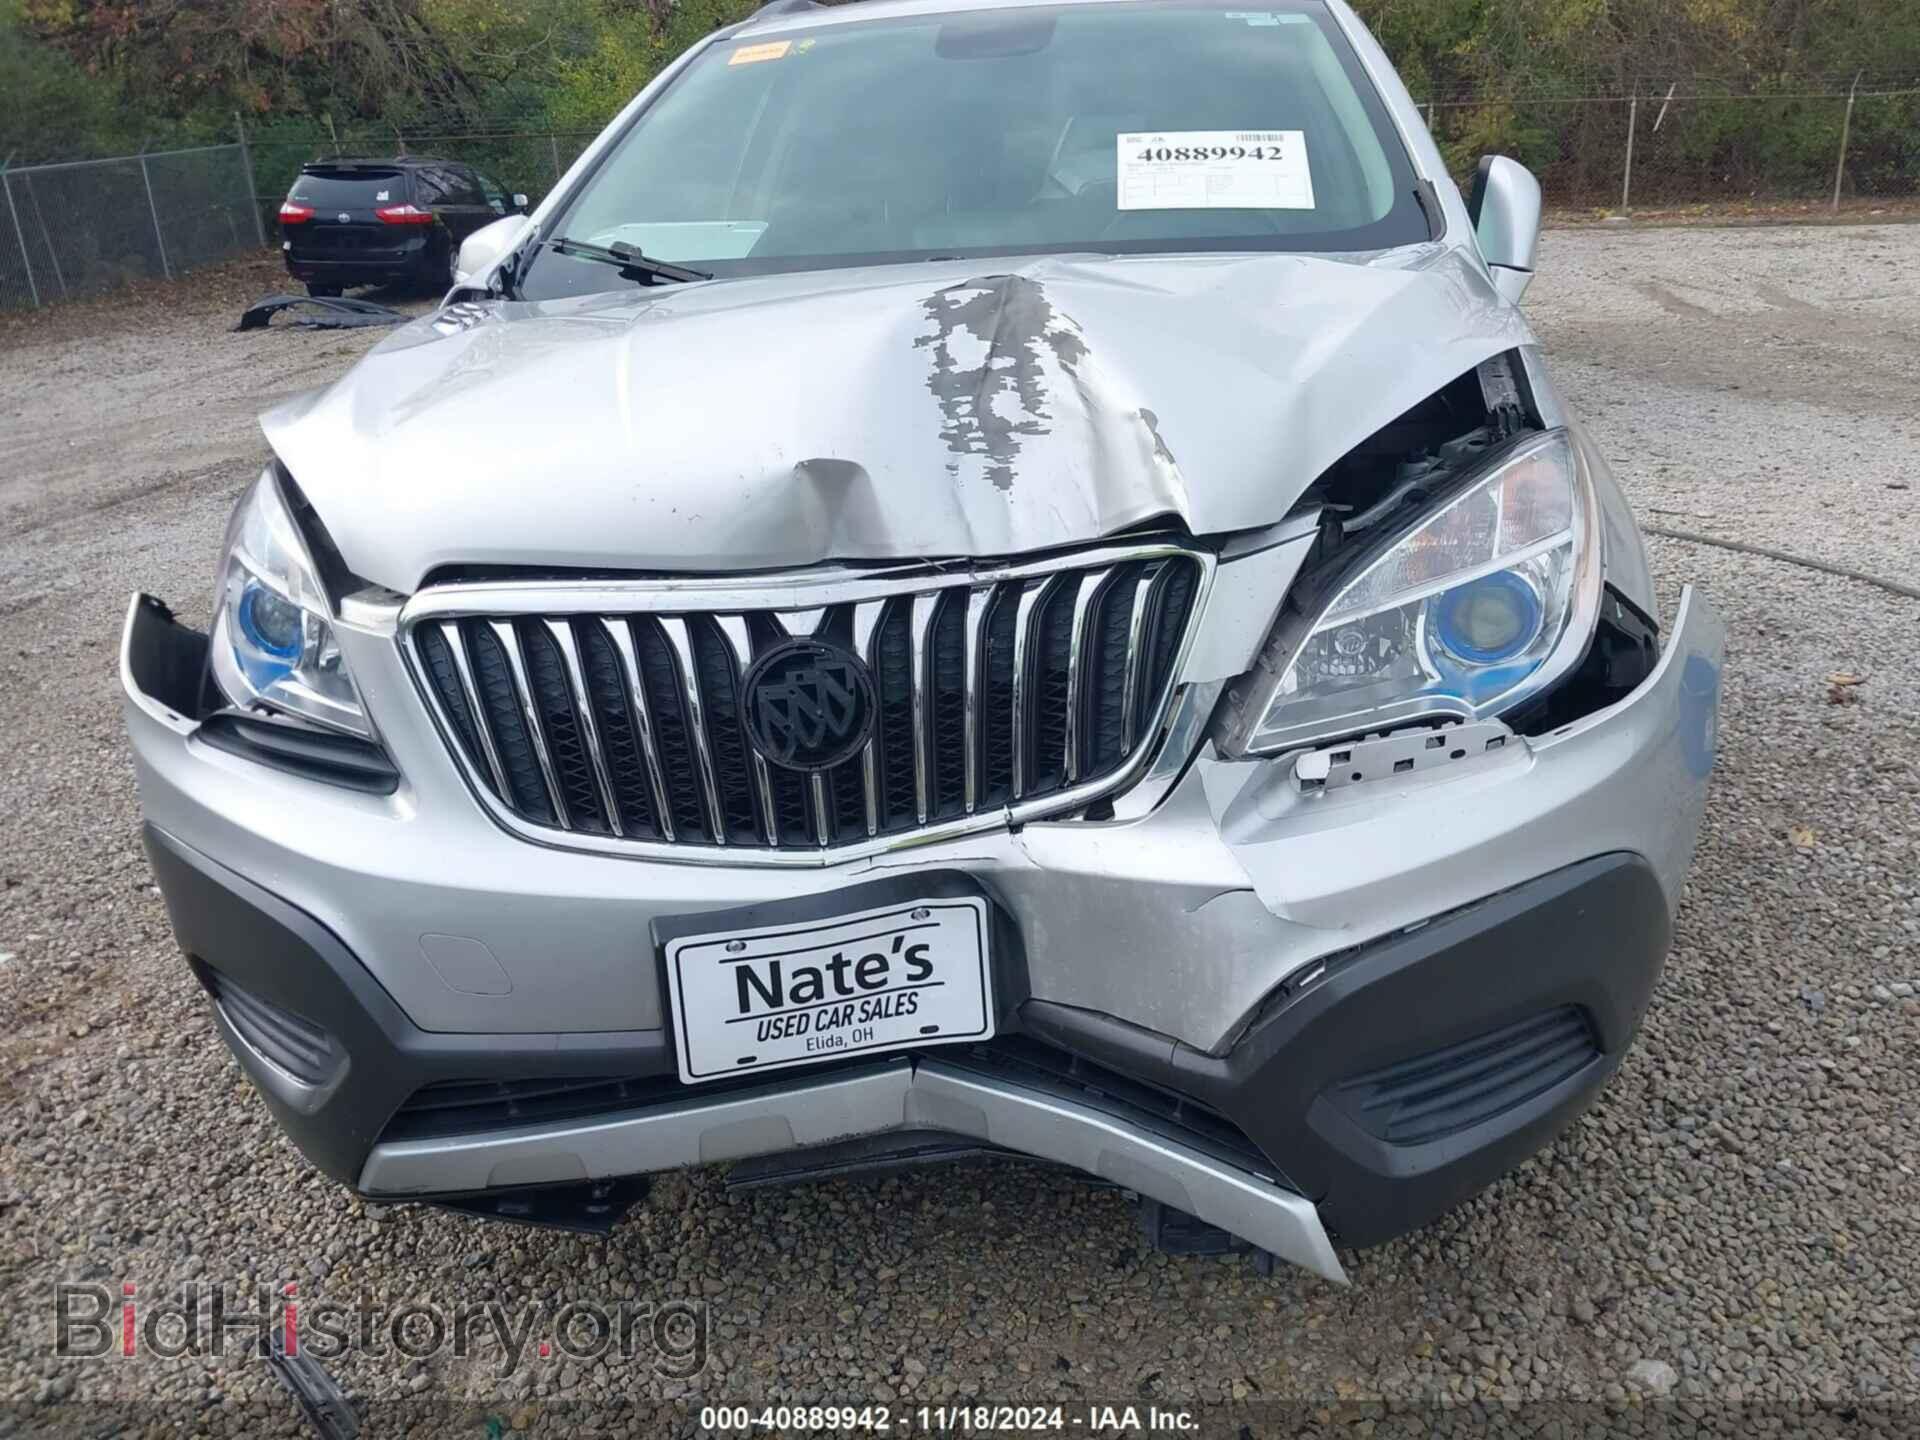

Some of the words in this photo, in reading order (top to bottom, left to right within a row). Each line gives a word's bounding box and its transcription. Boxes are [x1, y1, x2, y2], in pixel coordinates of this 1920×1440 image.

[1137, 146, 1283, 162] 40889942
[735, 935, 934, 1014] Nate's
[756, 1012, 811, 1042] USED
[815, 1002, 855, 1031] CAR
[858, 991, 919, 1023] SALES
[806, 1033, 848, 1052] Elida,
[852, 1027, 874, 1043] OH
